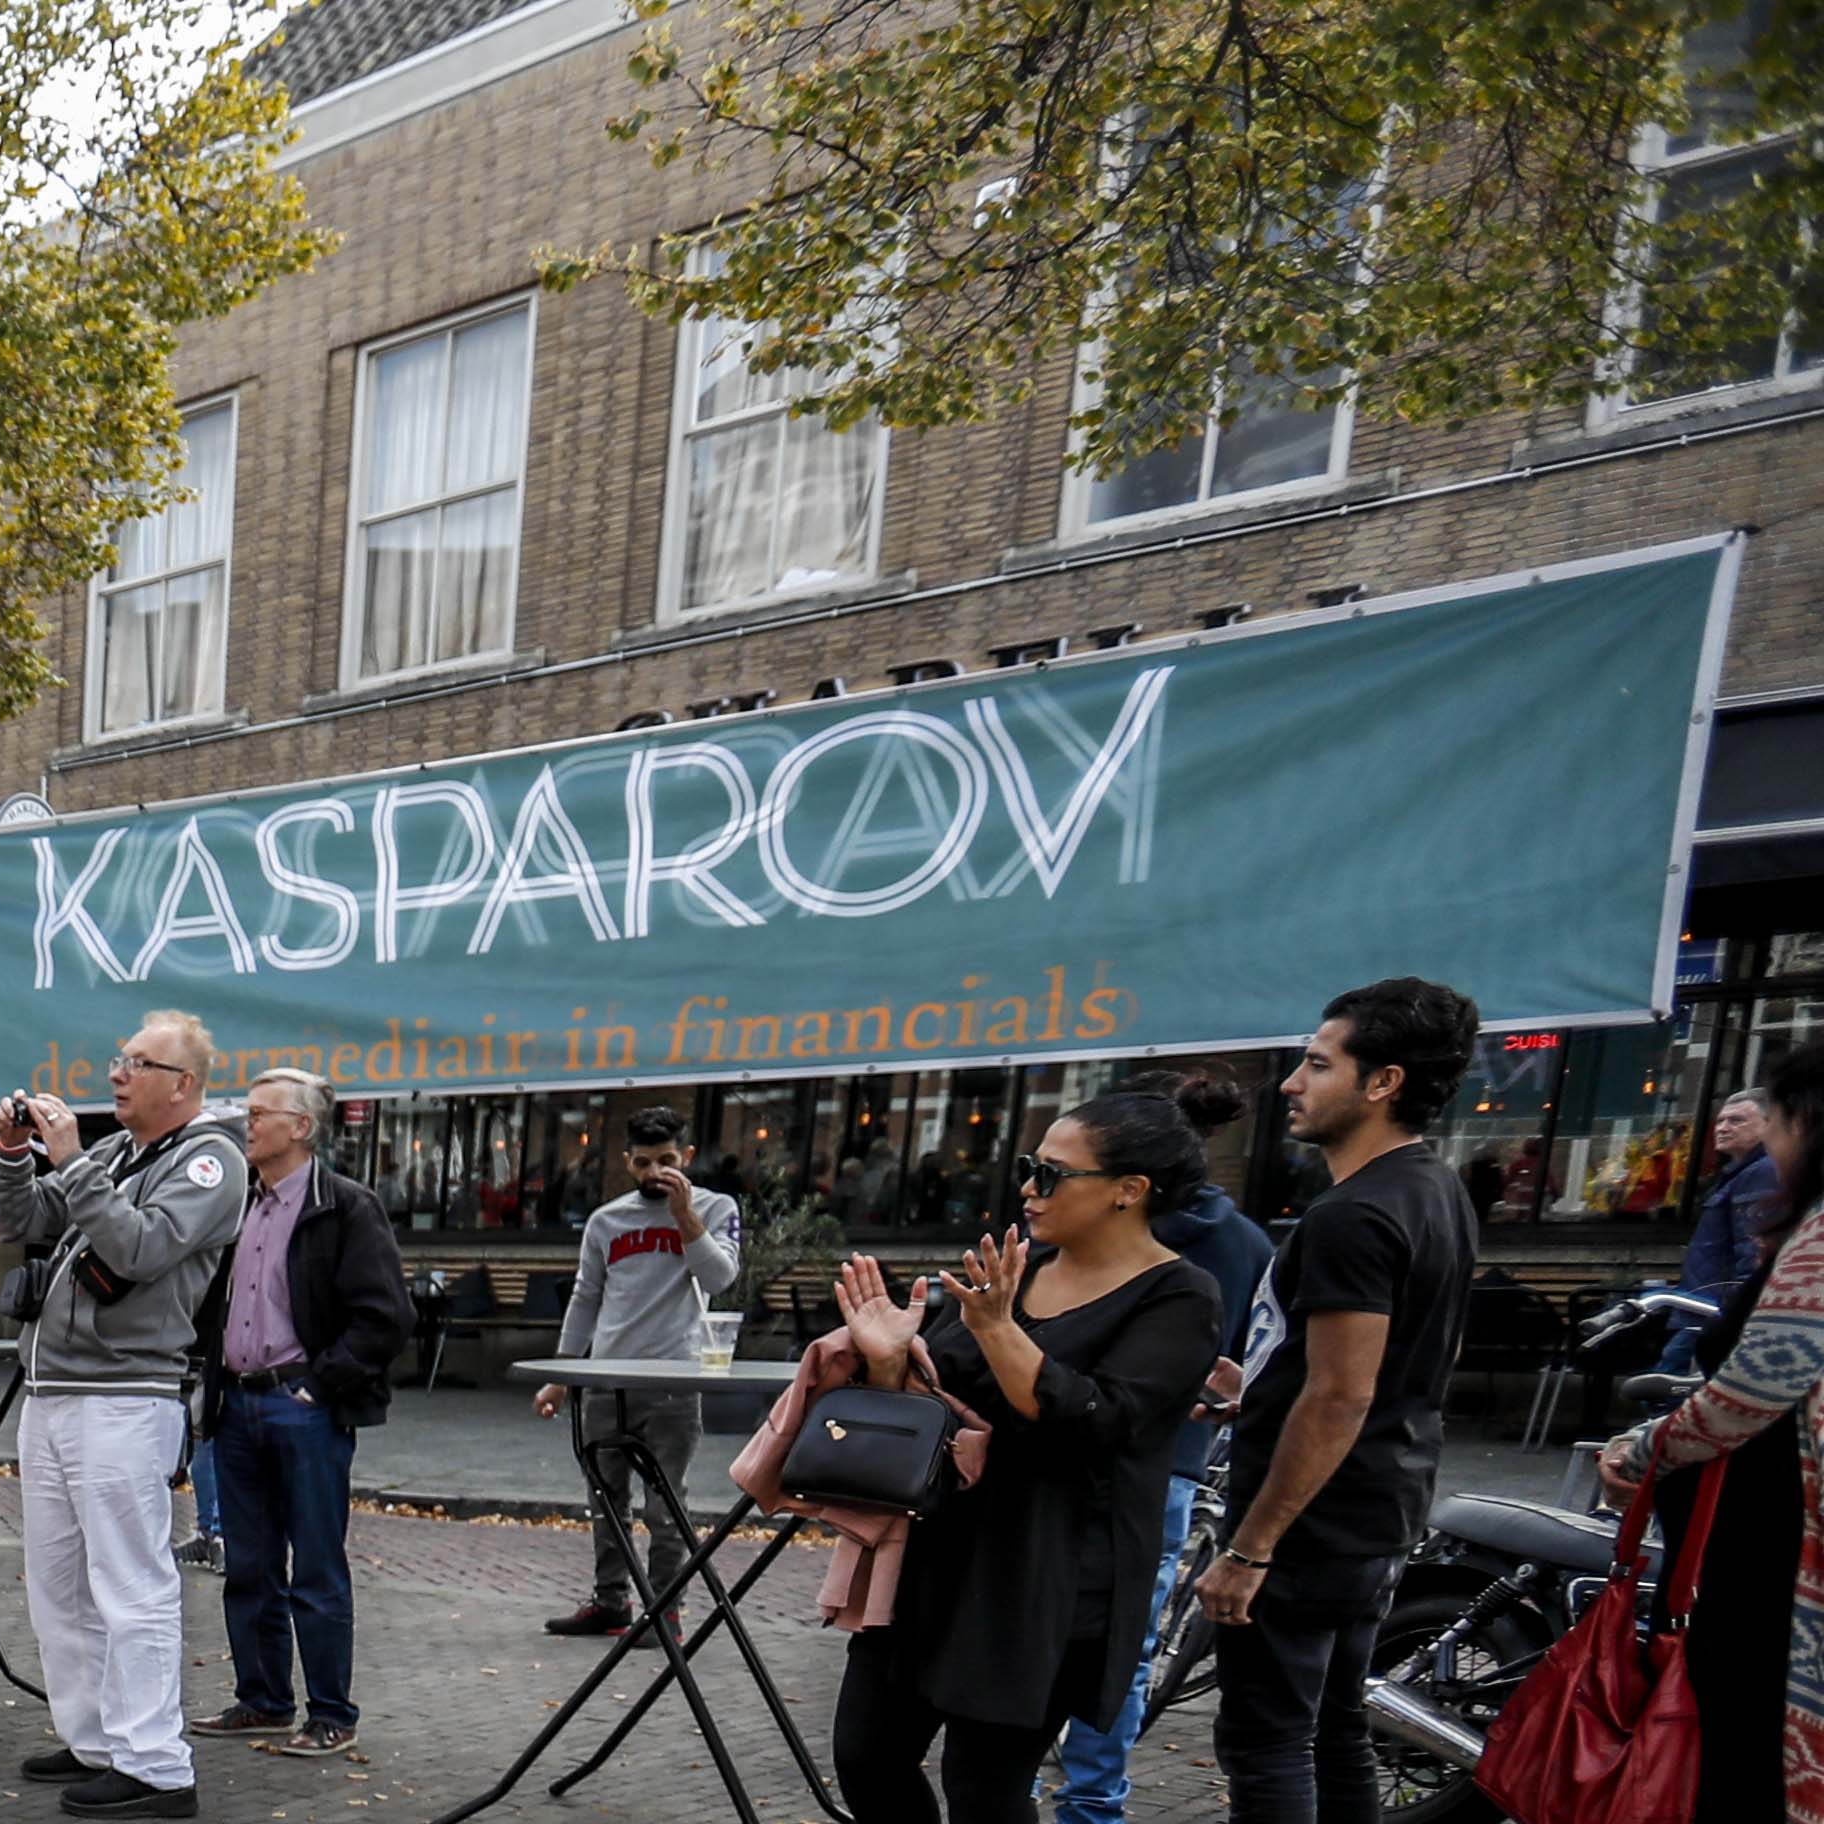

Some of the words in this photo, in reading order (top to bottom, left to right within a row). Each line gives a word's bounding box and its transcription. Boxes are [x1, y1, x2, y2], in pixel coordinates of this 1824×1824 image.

[32, 665, 1174, 989] KASPAROV
[31, 1041, 93, 1098] de
[116, 1011, 535, 1091] ermediair
[562, 1006, 638, 1071] in
[661, 964, 1122, 1064] financials
